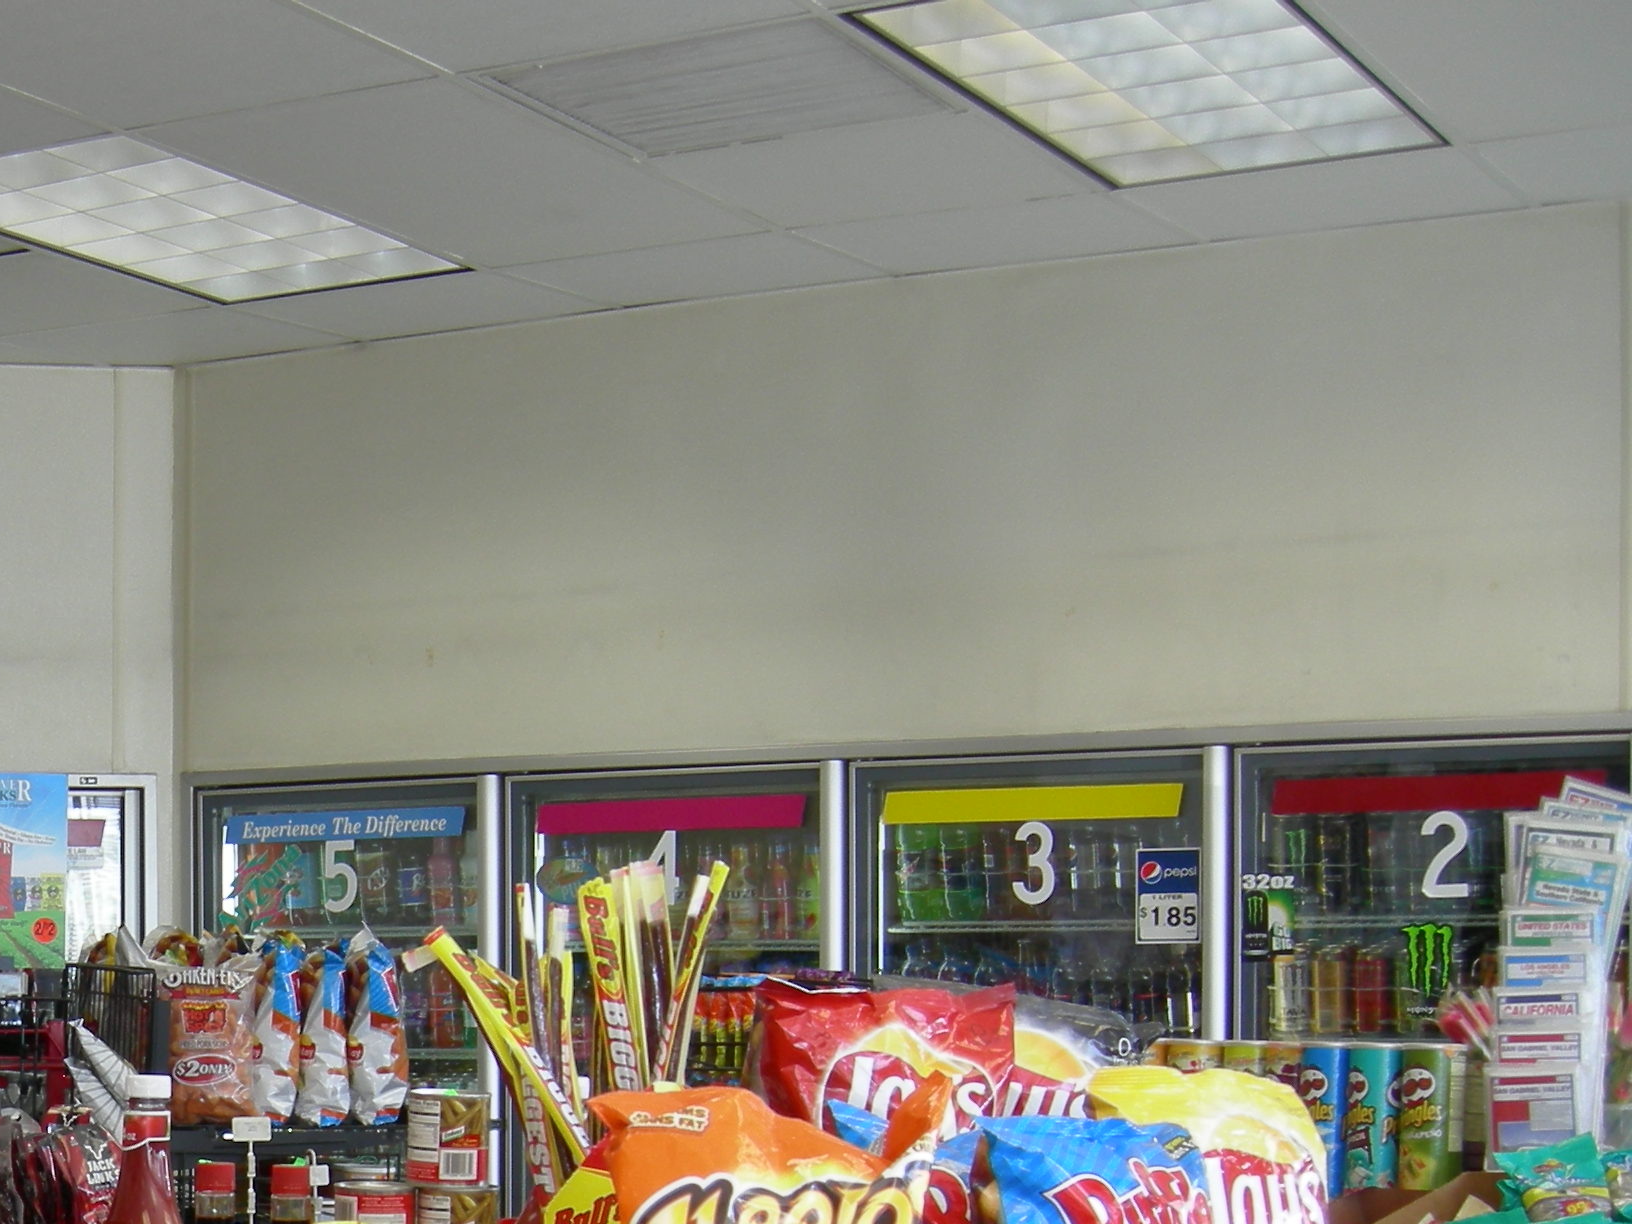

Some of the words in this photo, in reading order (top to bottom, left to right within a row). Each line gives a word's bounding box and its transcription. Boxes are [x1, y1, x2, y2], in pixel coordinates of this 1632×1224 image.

[243, 820, 325, 842] Experience
[333, 816, 361, 835] The
[365, 816, 447, 836] Difference
[1012, 821, 1055, 904] 3
[1420, 811, 1468, 898] 2
[324, 840, 357, 913] 5
[1164, 866, 1197, 878] pepsi
[1243, 874, 1294, 889] 32oz
[1518, 922, 1550, 931] UNITED
[1552, 922, 1587, 931] STATES
[1504, 1004, 1574, 1017] CALIFORNIA
[604, 1000, 638, 1091] BIGG
[87, 1158, 115, 1173] JACK
